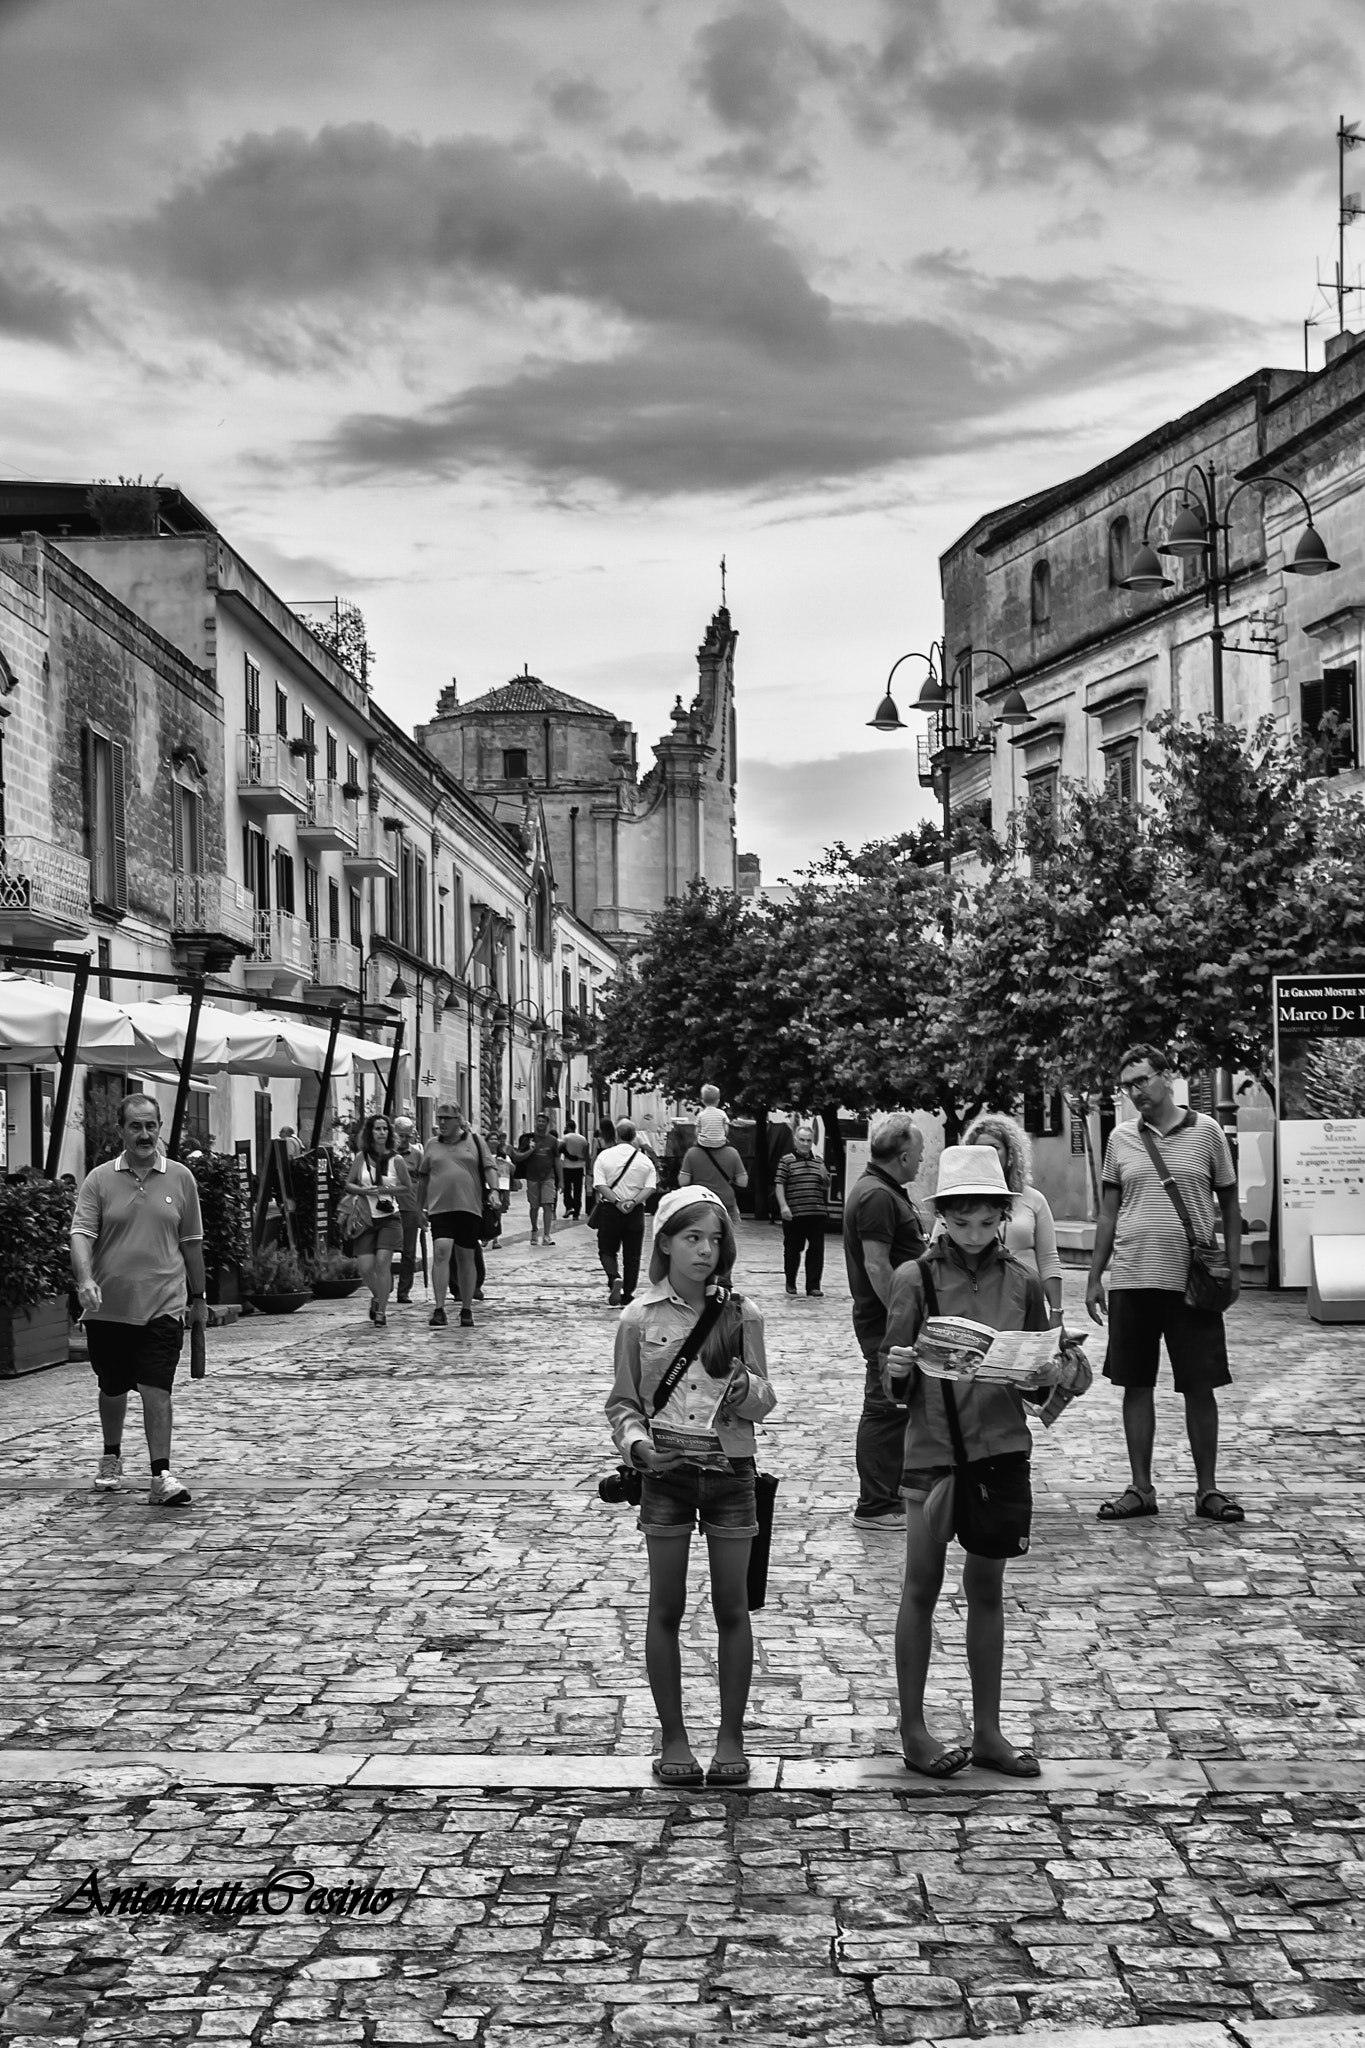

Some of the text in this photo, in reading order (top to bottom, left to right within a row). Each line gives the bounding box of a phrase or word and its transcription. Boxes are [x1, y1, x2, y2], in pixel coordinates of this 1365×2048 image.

[1291, 987, 1324, 998] GRANDI
[1324, 986, 1358, 997] MOSTRE
[1279, 1006, 1328, 1021] Marco
[1331, 1005, 1355, 1020] De
[1325, 1134, 1357, 1142] MATERA
[665, 1357, 687, 1386] Canon
